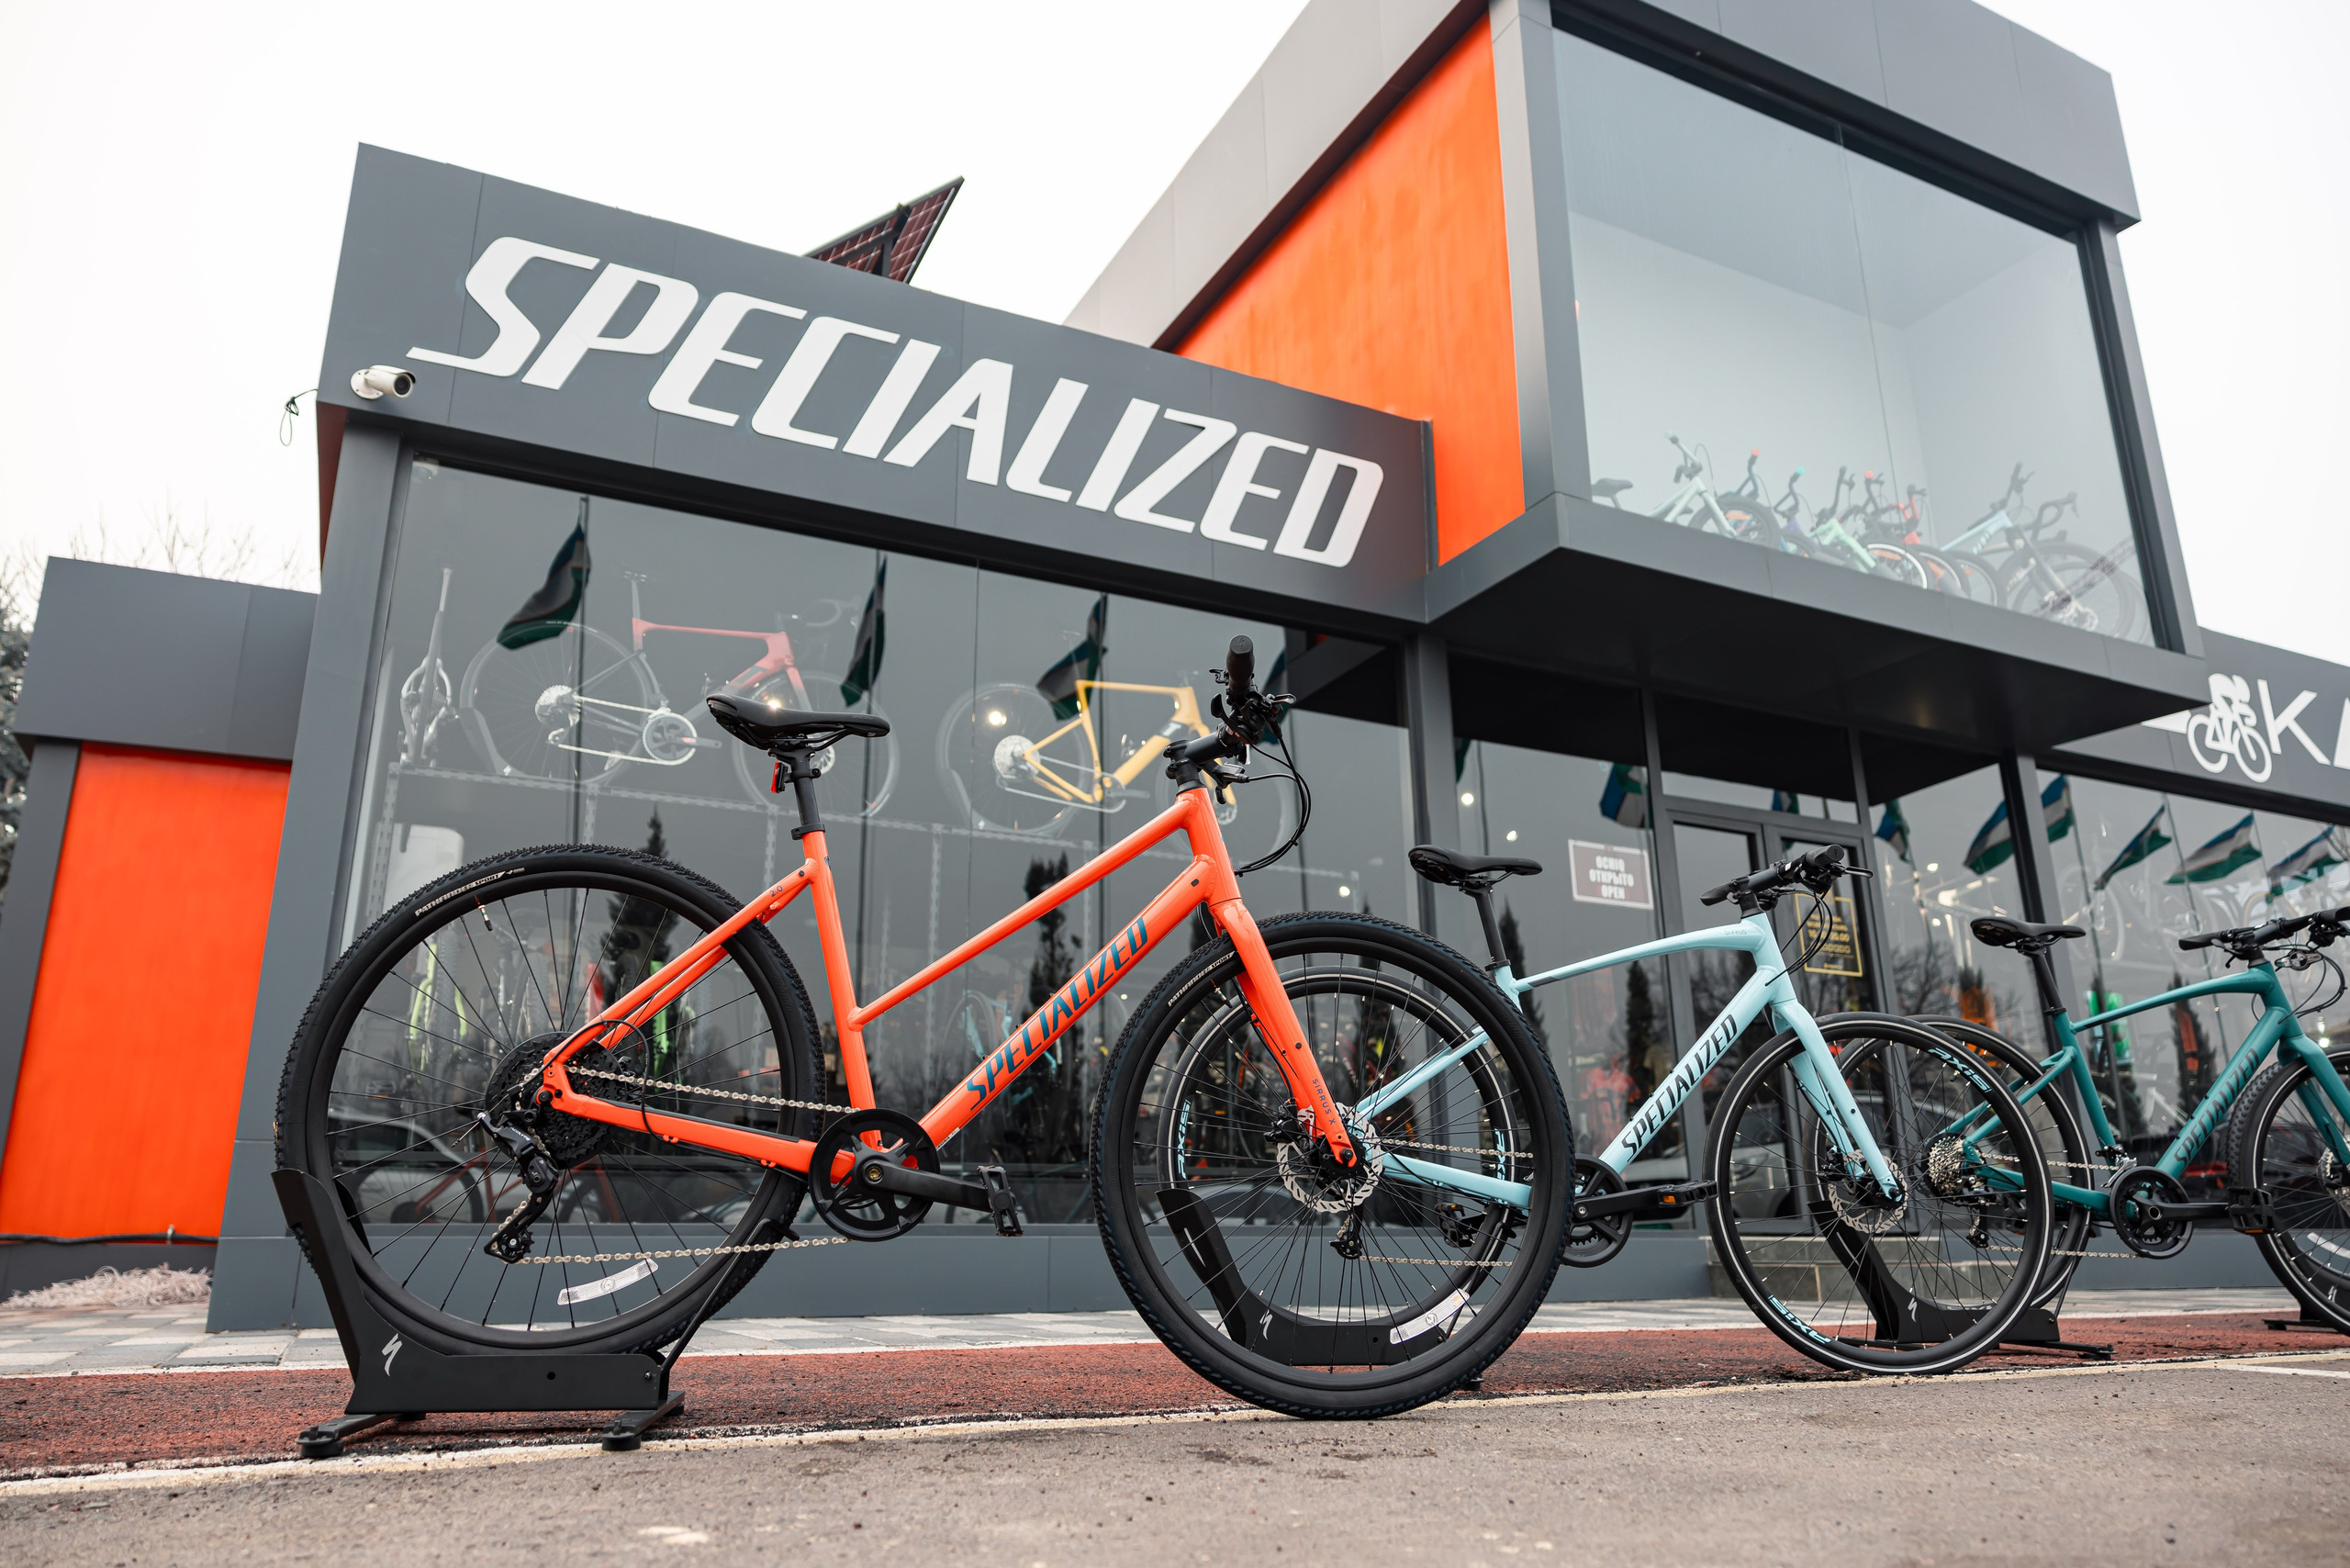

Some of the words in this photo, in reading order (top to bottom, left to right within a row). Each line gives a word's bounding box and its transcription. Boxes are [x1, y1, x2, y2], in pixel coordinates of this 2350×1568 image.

[406, 236, 1384, 567] SPECIALIZED
[414, 883, 475, 917] PATHFINDER
[474, 872, 501, 887] SPORT
[769, 885, 783, 898] 2.0
[1600, 884, 1625, 900] OPEN
[967, 916, 1147, 1111] SPECIALIZED
[1313, 1078, 1332, 1114] SIRRUS
[1621, 1014, 1738, 1163] SPECIALIZED
[2174, 1047, 2260, 1166] SPECIALIZED
